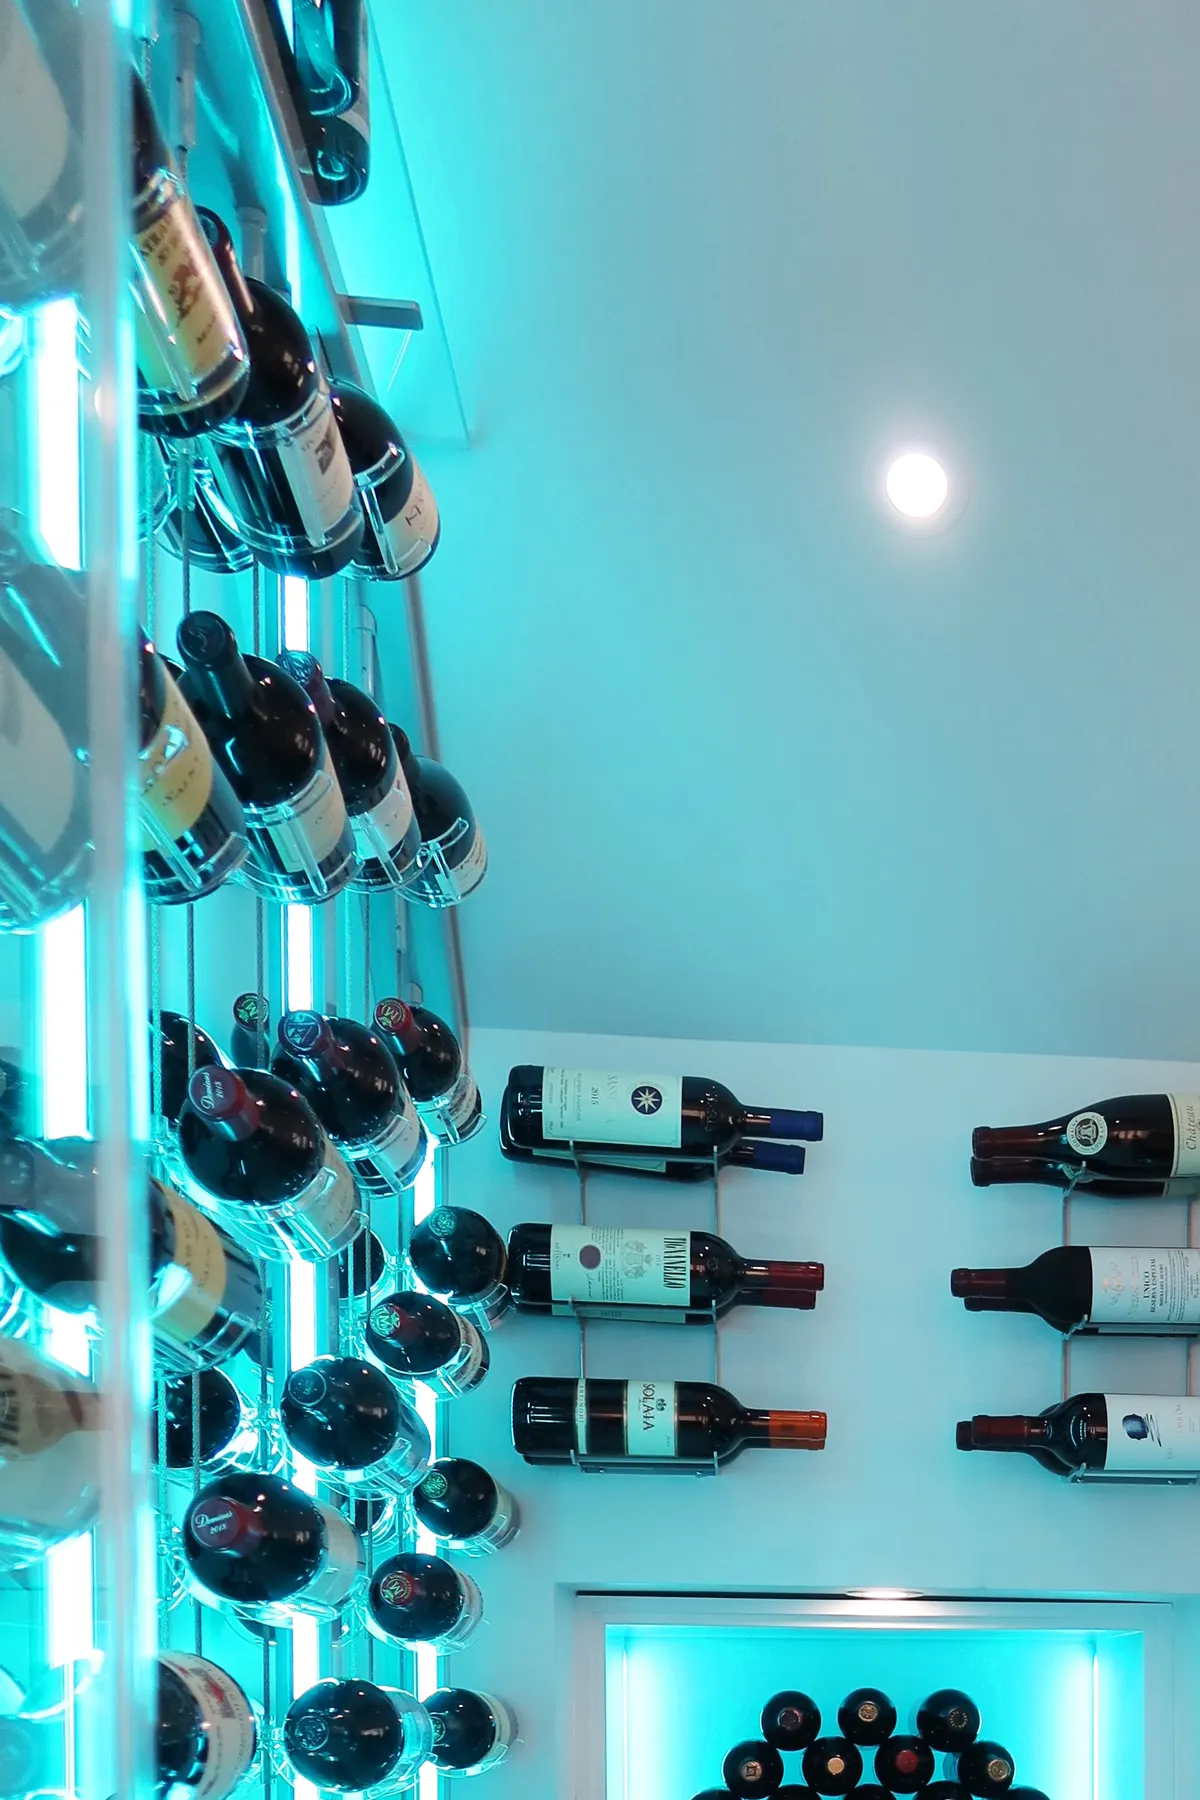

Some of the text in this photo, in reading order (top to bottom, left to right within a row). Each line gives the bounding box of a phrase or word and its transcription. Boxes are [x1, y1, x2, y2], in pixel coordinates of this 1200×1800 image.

[662, 1236, 687, 1289] TIGNANELLO
[642, 1383, 656, 1431] SOLAIA
[194, 1510, 233, 1529] Dominus
